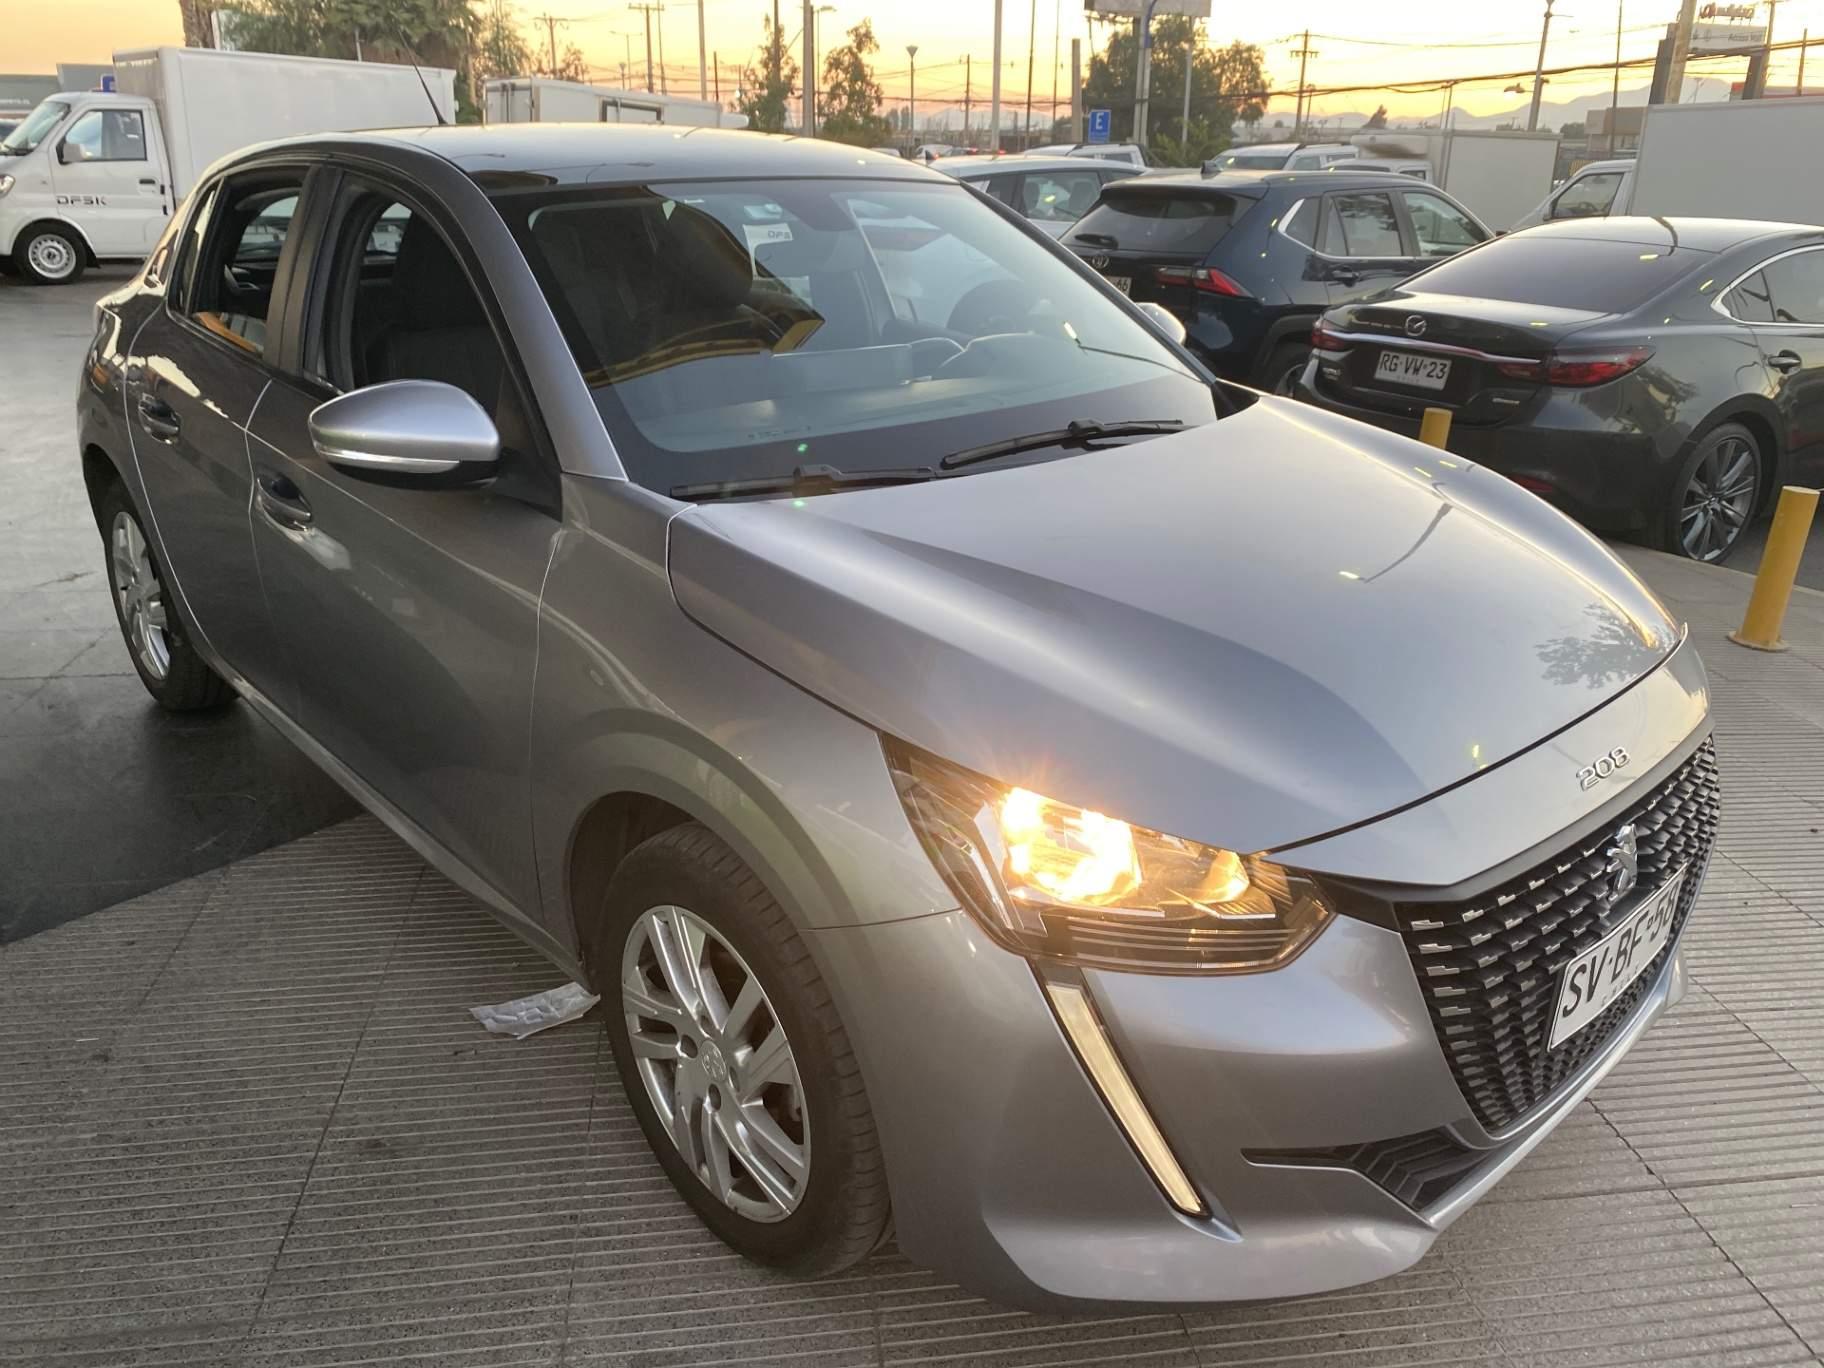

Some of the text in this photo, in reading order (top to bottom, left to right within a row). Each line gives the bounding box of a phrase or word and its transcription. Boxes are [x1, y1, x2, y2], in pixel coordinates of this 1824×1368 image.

[1095, 112, 1105, 130] E
[56, 195, 107, 205] DFSK
[1575, 746, 1630, 792] 208
